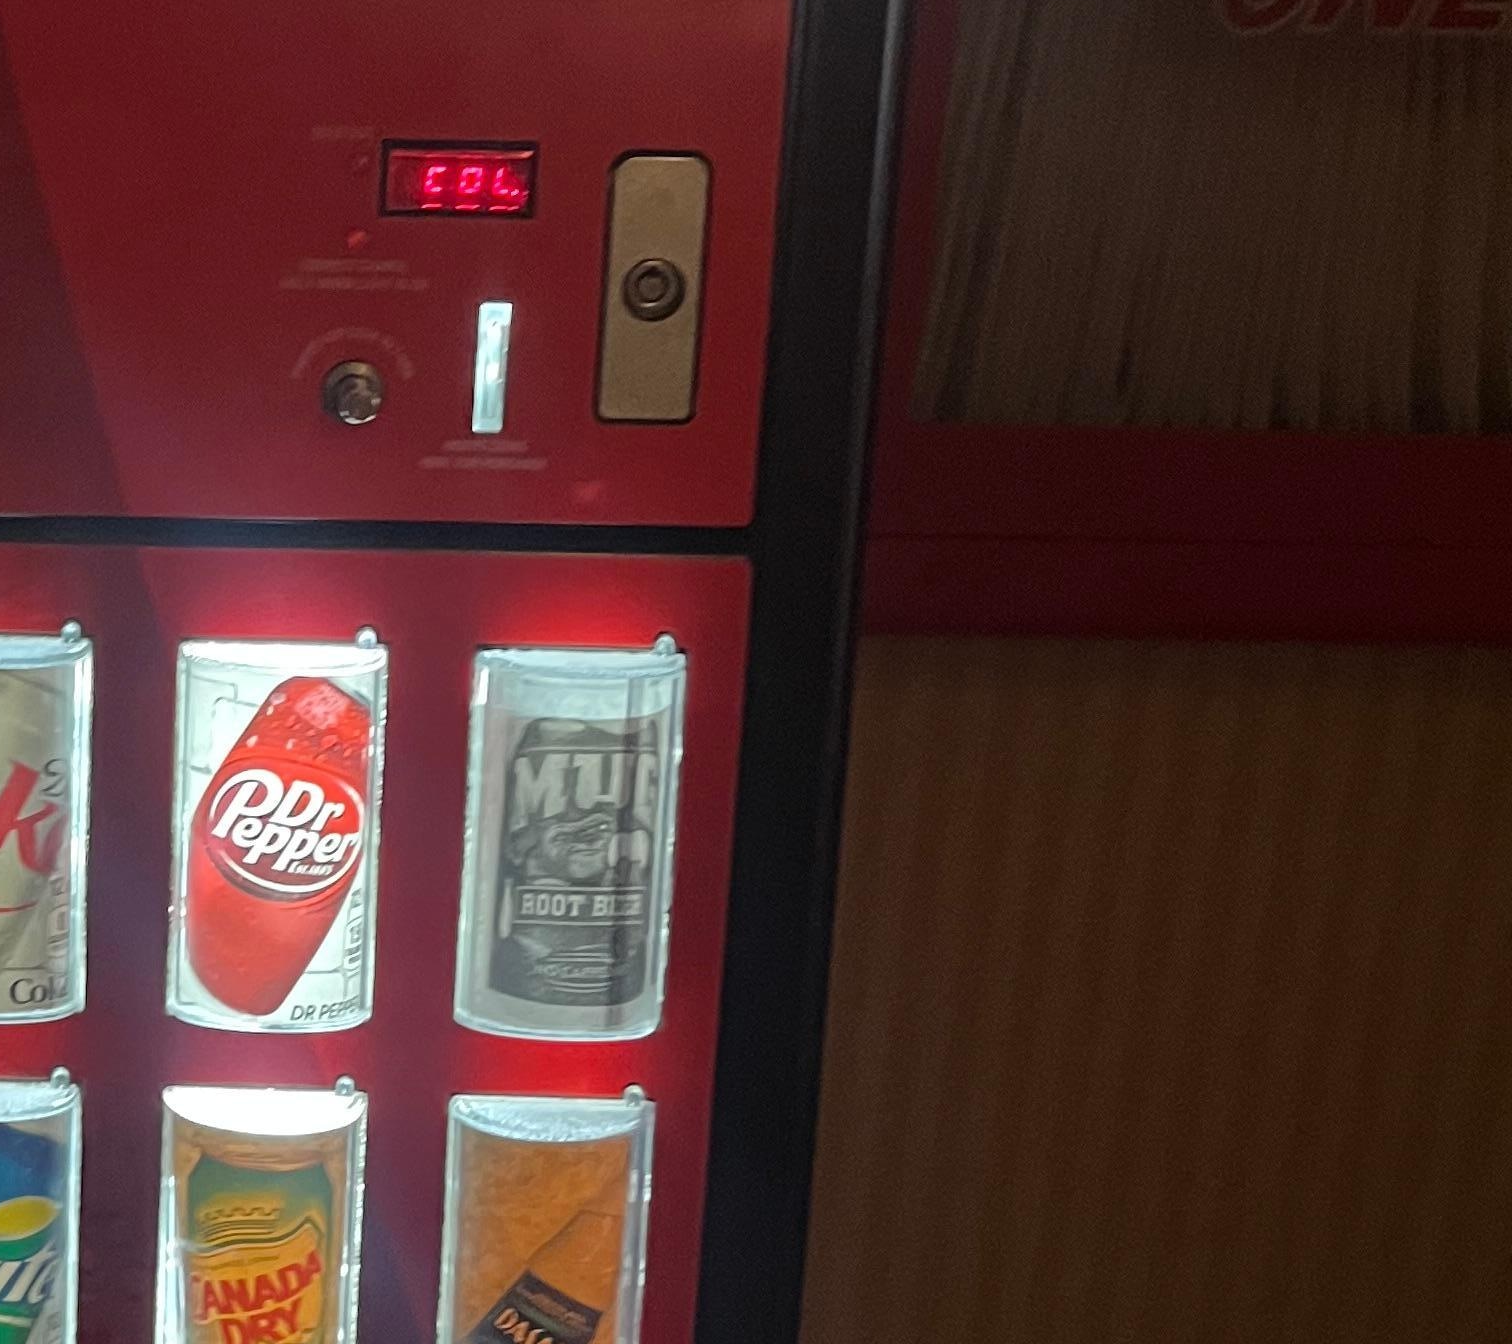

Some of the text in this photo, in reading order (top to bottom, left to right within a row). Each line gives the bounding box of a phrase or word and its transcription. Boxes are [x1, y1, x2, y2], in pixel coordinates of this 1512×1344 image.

[212, 768, 359, 873] Pepper
[276, 779, 345, 829] Dr
[521, 892, 587, 918] ROOT
